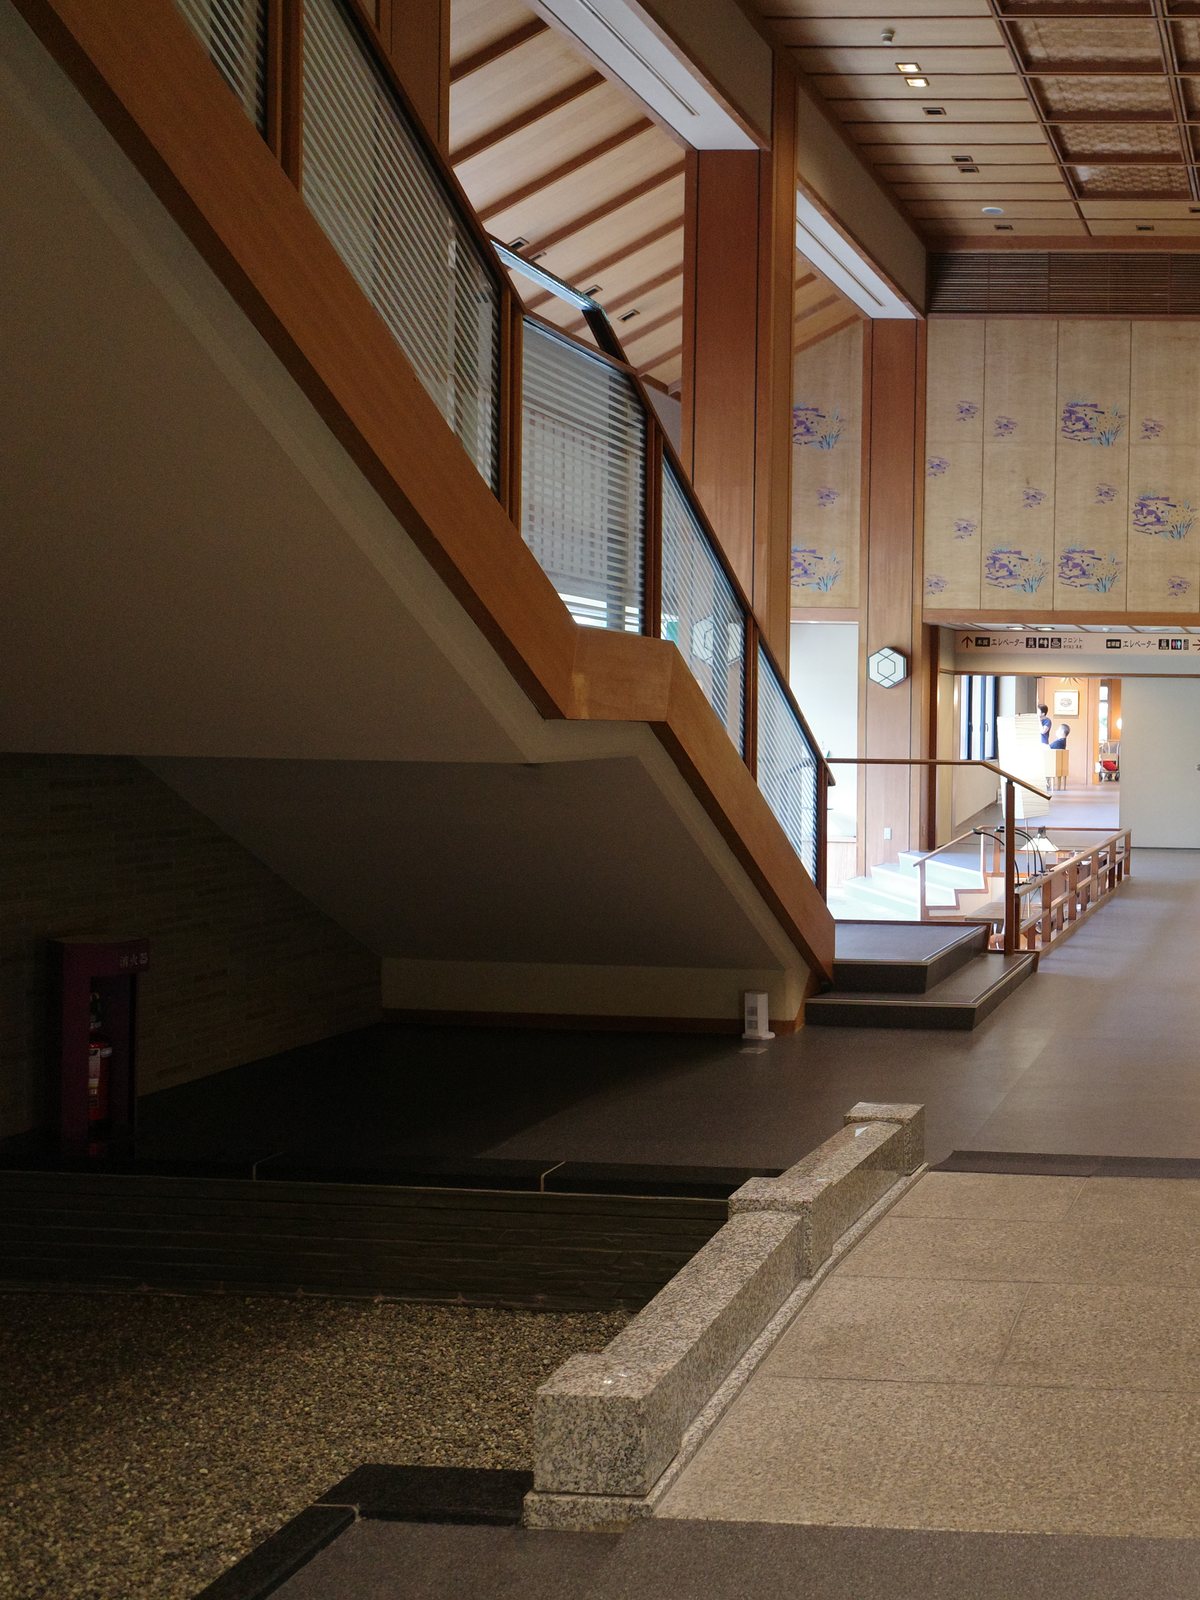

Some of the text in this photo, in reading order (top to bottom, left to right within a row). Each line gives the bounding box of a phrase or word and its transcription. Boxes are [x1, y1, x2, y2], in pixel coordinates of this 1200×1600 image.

[991, 638, 1024, 647] エレベーター
[1122, 639, 1157, 649] エレベーター
